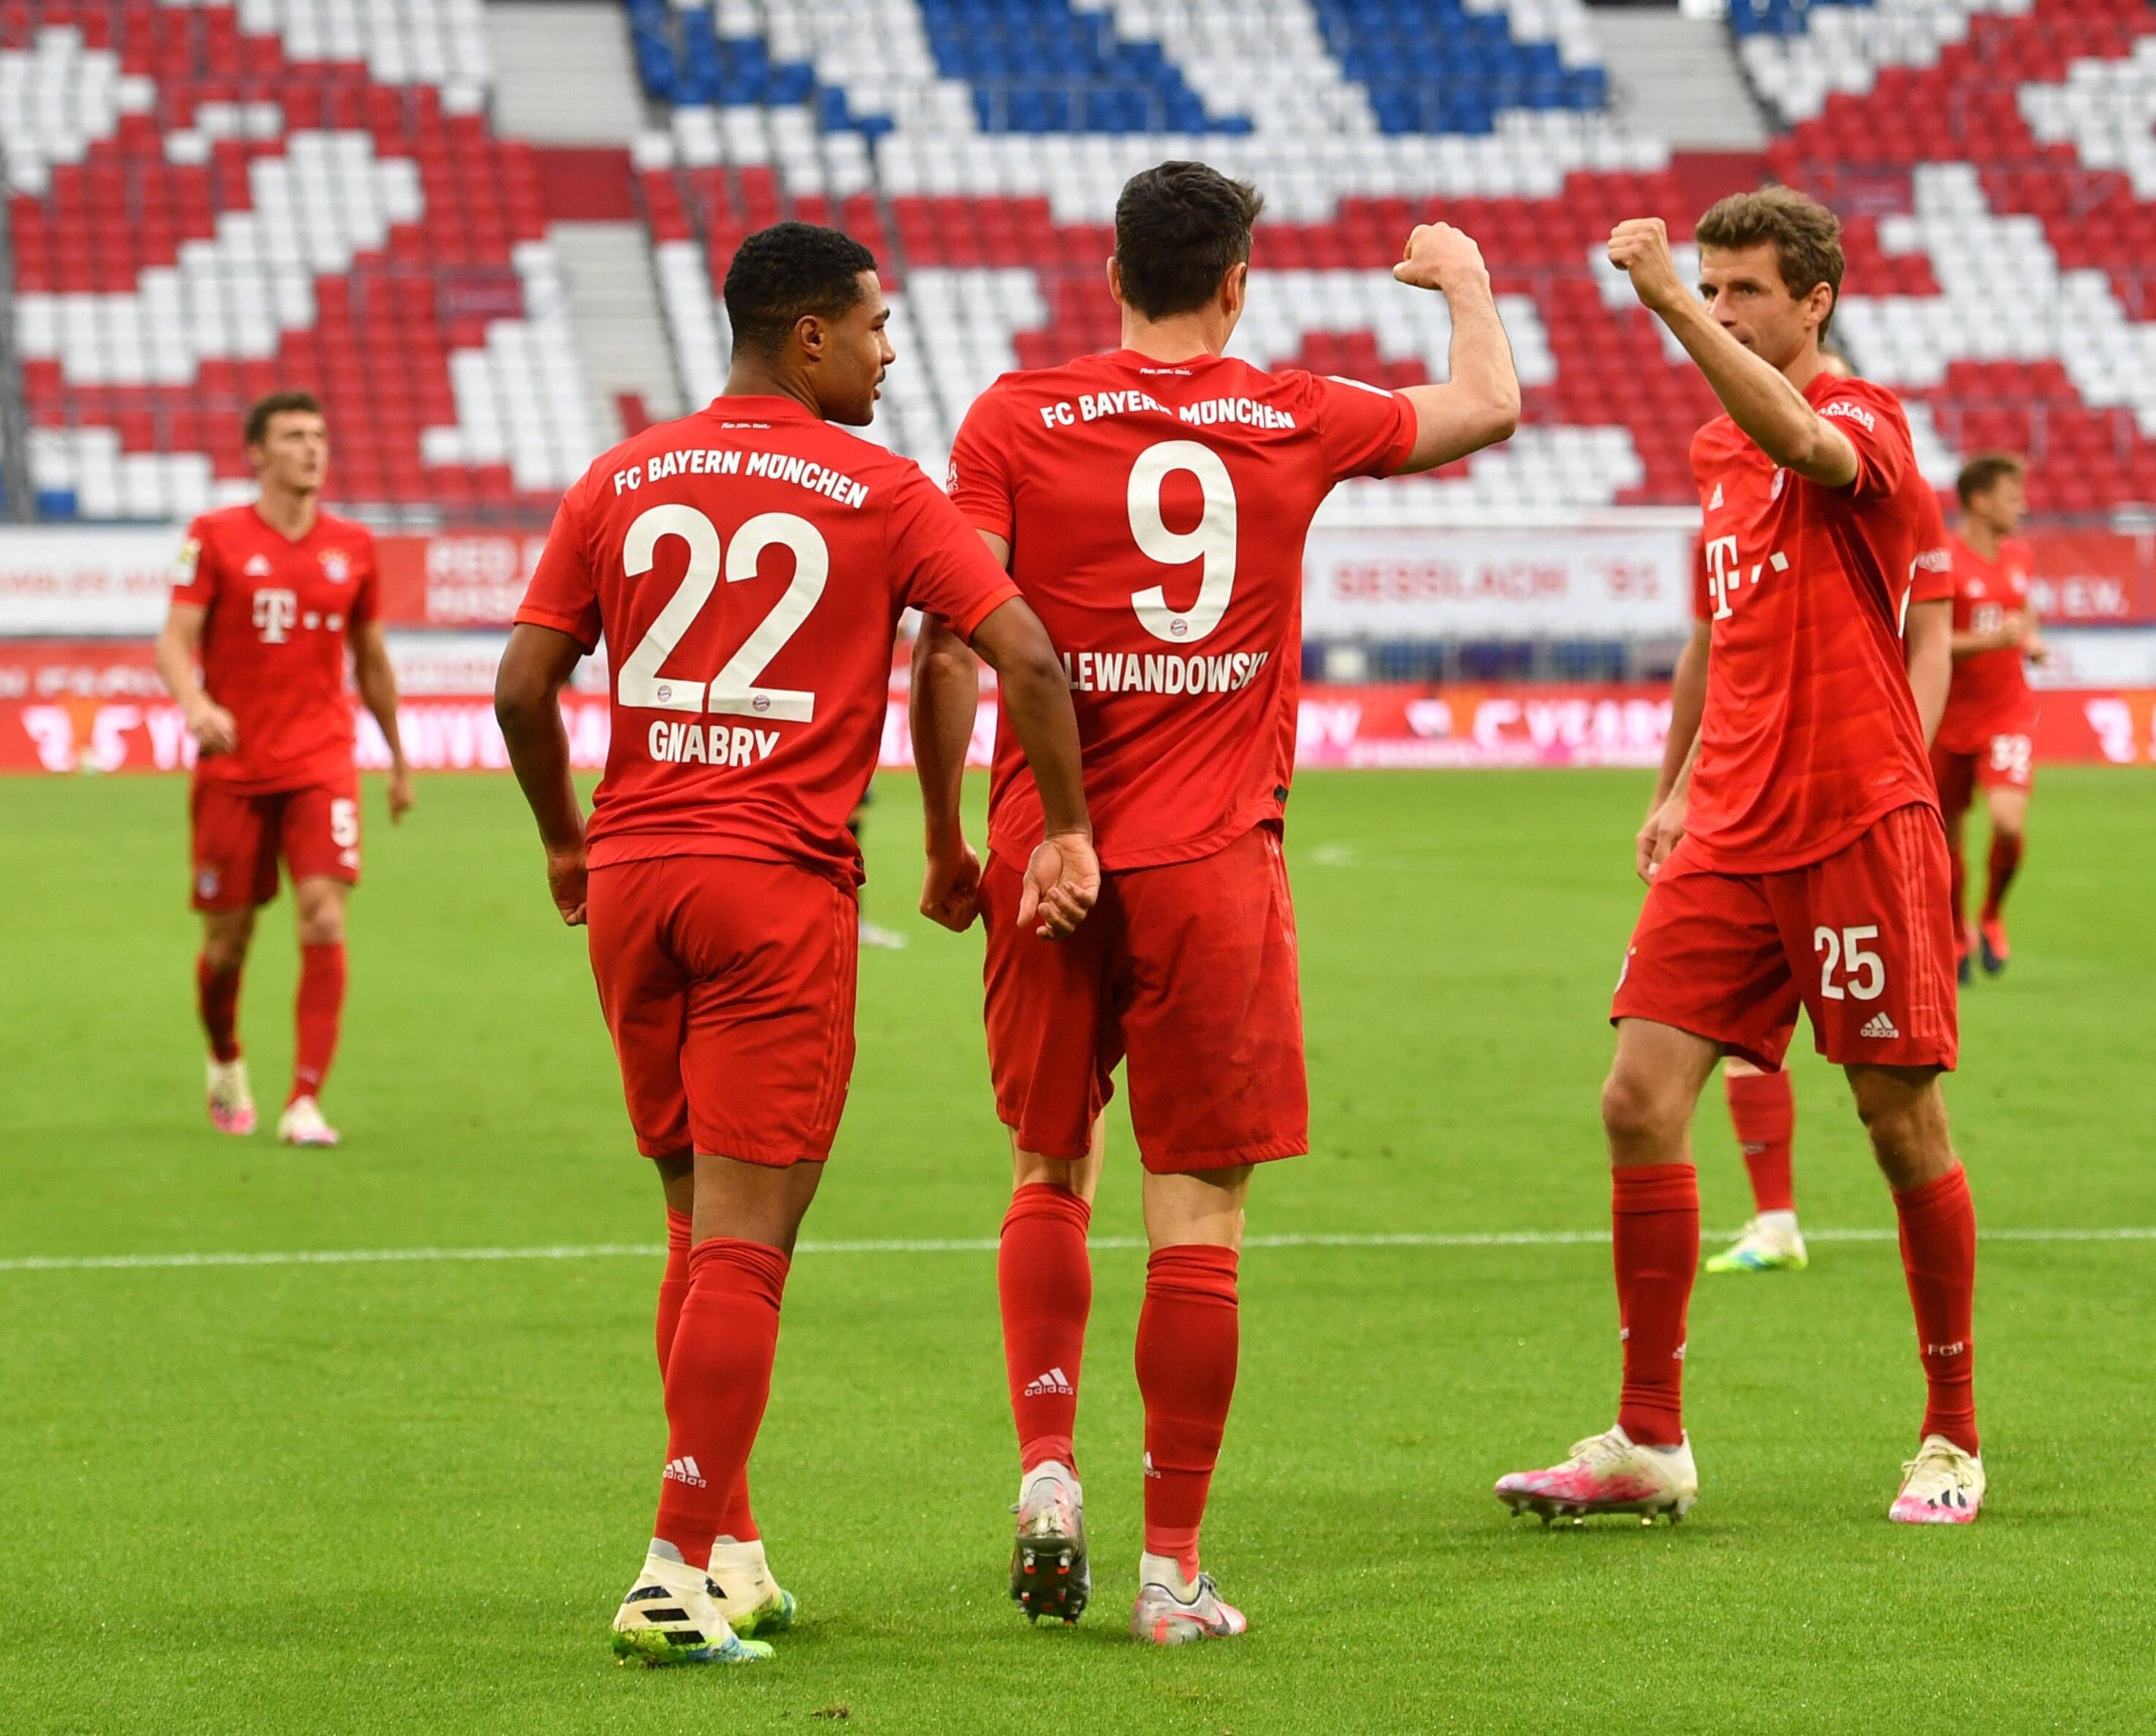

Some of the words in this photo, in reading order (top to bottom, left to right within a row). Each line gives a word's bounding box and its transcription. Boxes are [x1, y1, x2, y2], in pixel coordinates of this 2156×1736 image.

[1040, 402, 1075, 429] FC
[1179, 397, 1296, 429] MÜNCHEN
[613, 466, 642, 496] FC
[648, 449, 741, 482] BAYERN
[745, 451, 869, 509] MÜNCHEN
[1127, 440, 1237, 643] 9
[618, 504, 830, 723] 22
[649, 720, 780, 767] GNABRY
[330, 798, 358, 847] 5
[1814, 925, 1885, 1000] 25
[1860, 1028, 1899, 1039] adidas
[1928, 1341, 1963, 1356] FCB
[1024, 1384, 1073, 1396] adidas
[662, 1469, 707, 1488] adidas
